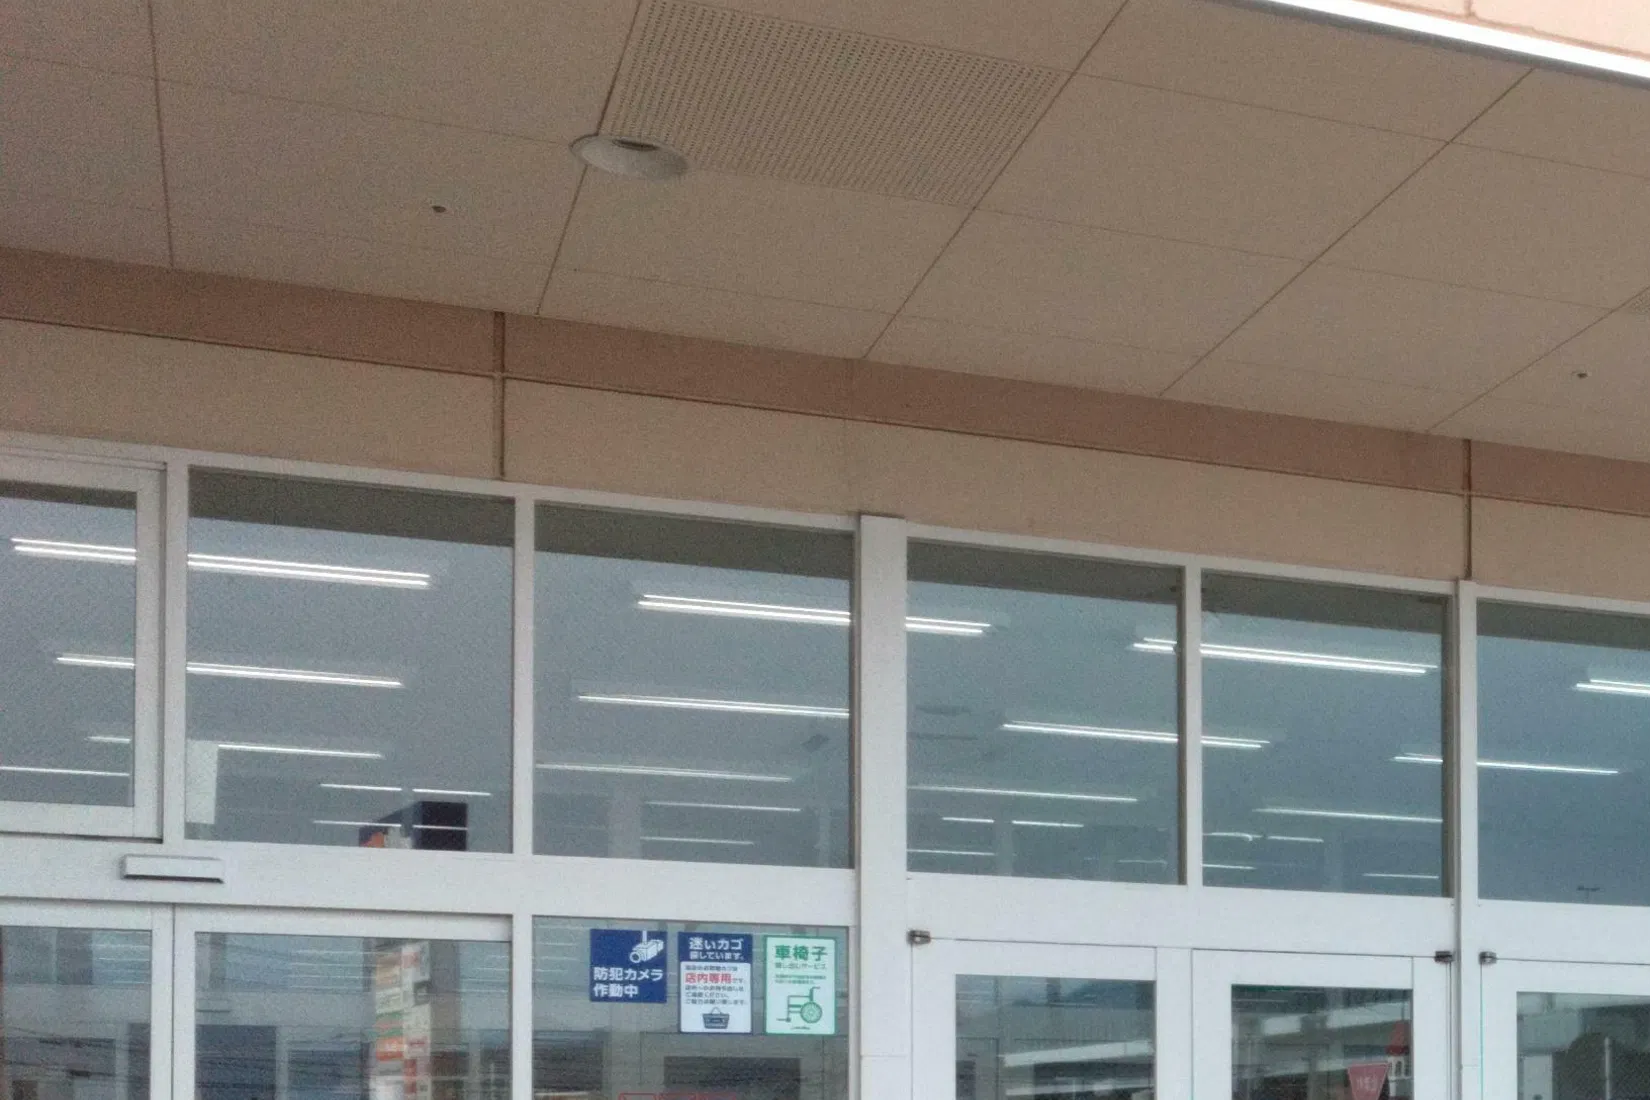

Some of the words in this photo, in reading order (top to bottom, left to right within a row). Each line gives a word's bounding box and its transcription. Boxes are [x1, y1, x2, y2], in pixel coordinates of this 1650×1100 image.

[689, 937, 744, 950] 迷いカゴ
[775, 945, 828, 961] 車椅子
[593, 967, 663, 981] 防犯カメラ
[593, 983, 638, 998] 作動中
